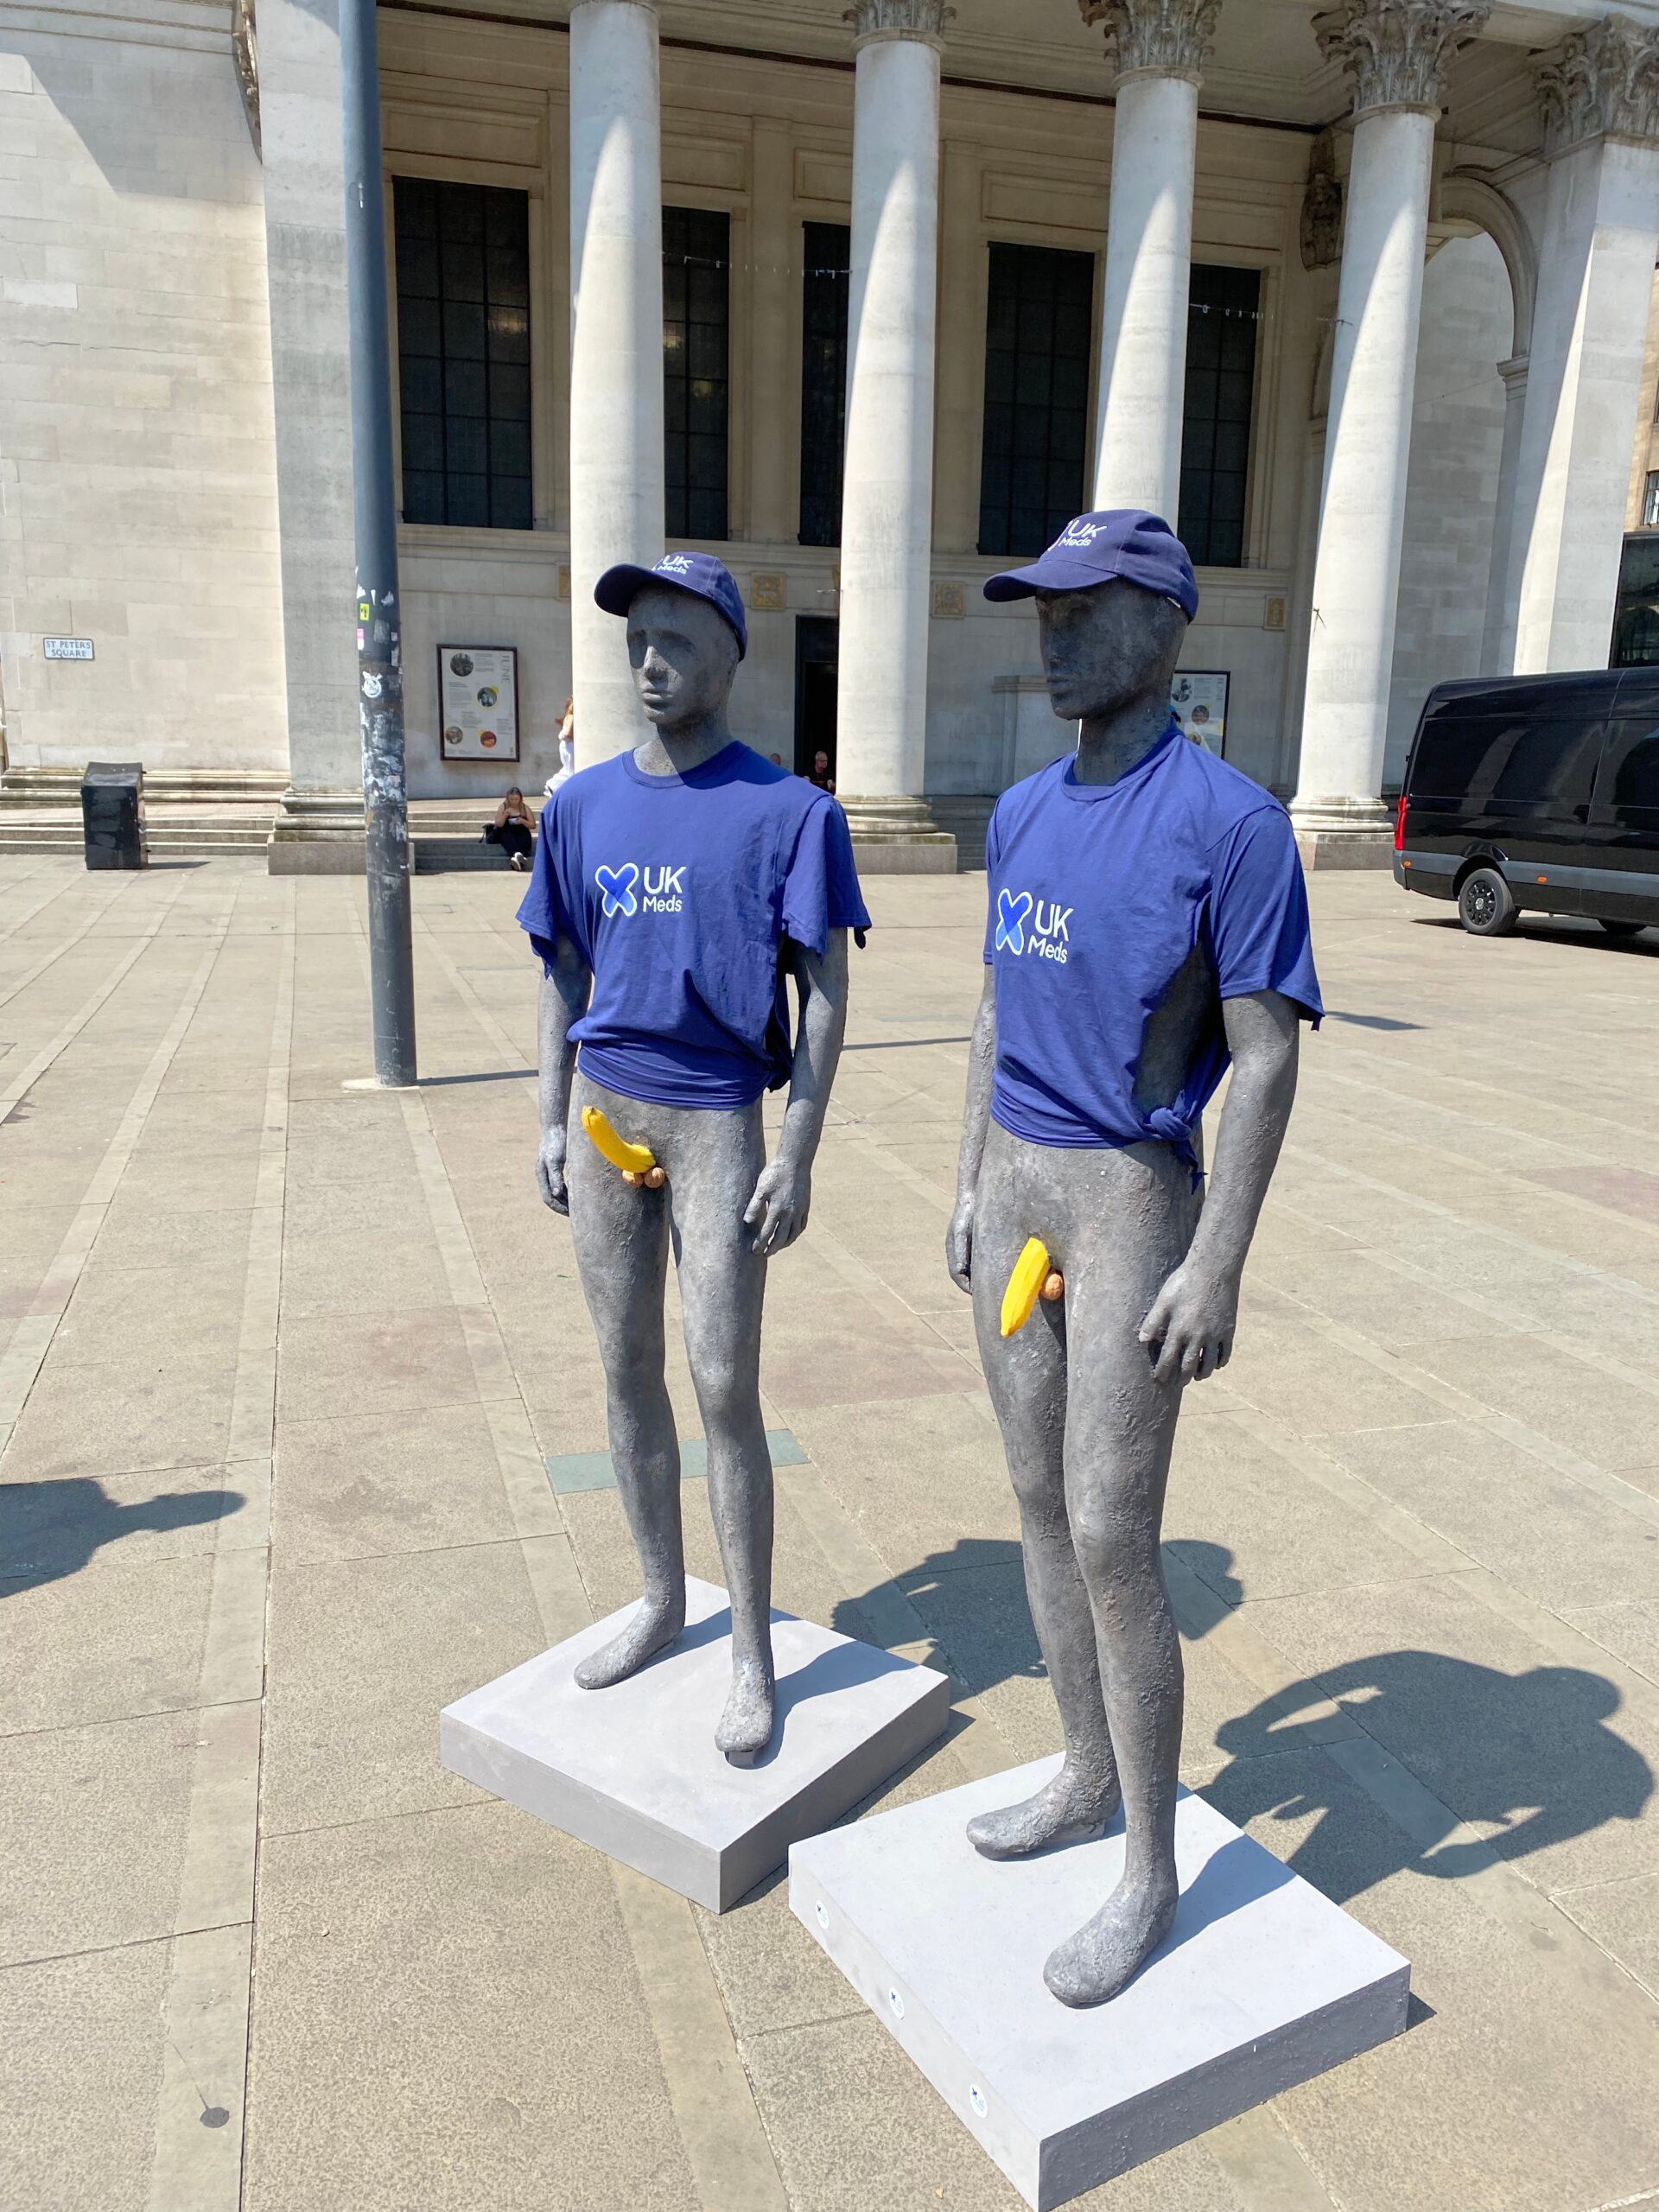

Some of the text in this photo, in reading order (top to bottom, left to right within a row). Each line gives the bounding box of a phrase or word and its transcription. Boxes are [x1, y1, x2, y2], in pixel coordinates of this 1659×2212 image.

[1067, 520, 1108, 537] UK
[1060, 537, 1092, 547] Meds
[664, 554, 693, 568] UK
[658, 565, 687, 575] Meds
[51, 649, 87, 658] SQUARE
[644, 866, 687, 894] UK
[643, 894, 683, 912] Meds
[1035, 899, 1074, 942] UK
[1027, 935, 1067, 964] Meds
